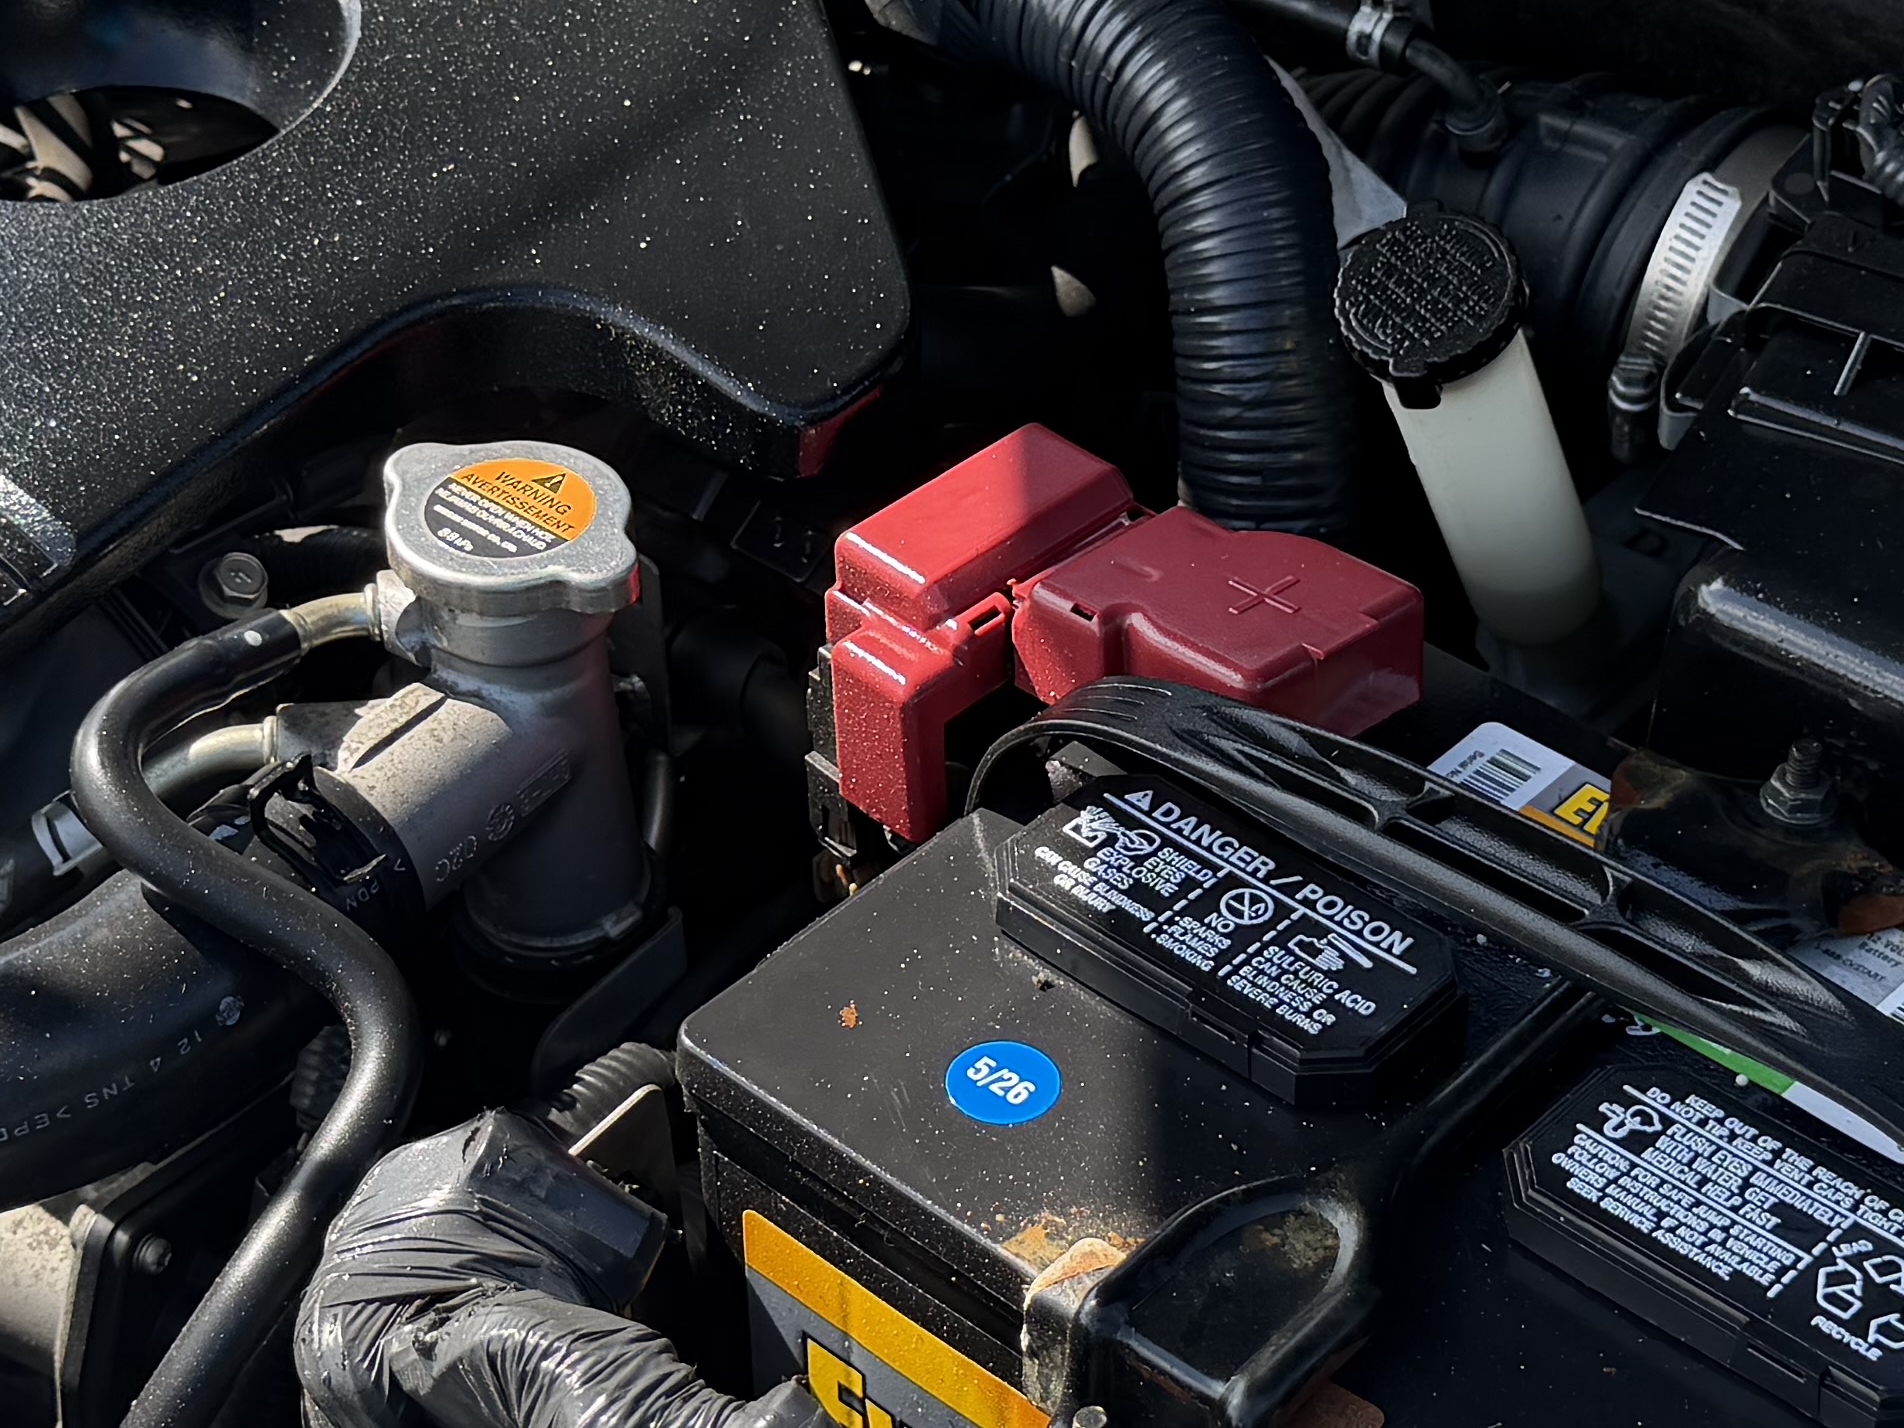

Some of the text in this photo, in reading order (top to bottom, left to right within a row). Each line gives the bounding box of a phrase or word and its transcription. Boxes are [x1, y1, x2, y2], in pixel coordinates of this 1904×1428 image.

[461, 473, 575, 533] AVERTISSEMENT
[495, 471, 572, 515] WARNING
[1034, 846, 1156, 921] CAN CAUSE BLINDNESS
[1084, 857, 1134, 890] GASES
[1097, 846, 1179, 898] EXPLOSIVE
[1143, 856, 1186, 884] EYES
[1152, 801, 1414, 956] DANGER / POISON
[1158, 847, 1214, 882] SHIELD
[1053, 873, 1117, 913] OR INJURY
[1166, 925, 1219, 958] FLAMES
[1178, 916, 1232, 950] SPARKS
[1204, 912, 1236, 933] NO
[1156, 934, 1215, 972] SMOKING
[1859, 941, 1903, 968] Battery
[1226, 975, 1323, 1035] SEVERE BURNS
[1238, 965, 1337, 1026] BLINDNESS OR
[1251, 956, 1327, 1004] CAN CAUSE
[1263, 945, 1377, 1016] SULFURIC ACID
[84, 1074, 137, 1110] TNS
[966, 1056, 1036, 1105] 5/26
[1646, 1086, 1671, 1105] DO
[1670, 1101, 1705, 1124] NOT
[1731, 1136, 1773, 1162] KEEP
[1773, 1159, 1815, 1186] VENT
[1812, 1182, 1856, 1210] CAPS
[1855, 1204, 1904, 1235] TIGHT
[1655, 1134, 1696, 1164] WITH
[1744, 1187, 1779, 1210] GET
[1665, 1123, 1845, 1229] FLUSH EYES IMMEDIATELY
[1685, 1094, 1726, 1119] KEEP
[1723, 1117, 1759, 1140] OUT
[1757, 1135, 1783, 1151] OF
[1781, 1147, 1815, 1171] THE
[1812, 1165, 1865, 1200] REACH
[1864, 1194, 1891, 1211] OF
[1566, 1177, 1603, 1203] SEEK
[1599, 1196, 1657, 1234] SERVICE
[1566, 1145, 1782, 1273] FOLLOW INSTRUCTIONS IN VEHICLE
[1640, 1146, 1782, 1231] MEDICAL HELP FAST
[1551, 1152, 1608, 1188] OWNERS
[1660, 1216, 1680, 1228] IF
[1676, 1225, 1709, 1247] NOT
[1704, 1244, 1776, 1287] AVAILABLE
[1629, 1167, 1661, 1189] FOR
[1658, 1183, 1696, 1208] SAFE
[1691, 1204, 1732, 1228] JUMP
[1729, 1224, 1796, 1266] STARTING
[1831, 1239, 1874, 1259] LEAD
[1810, 1314, 1884, 1362] RECYCLE
